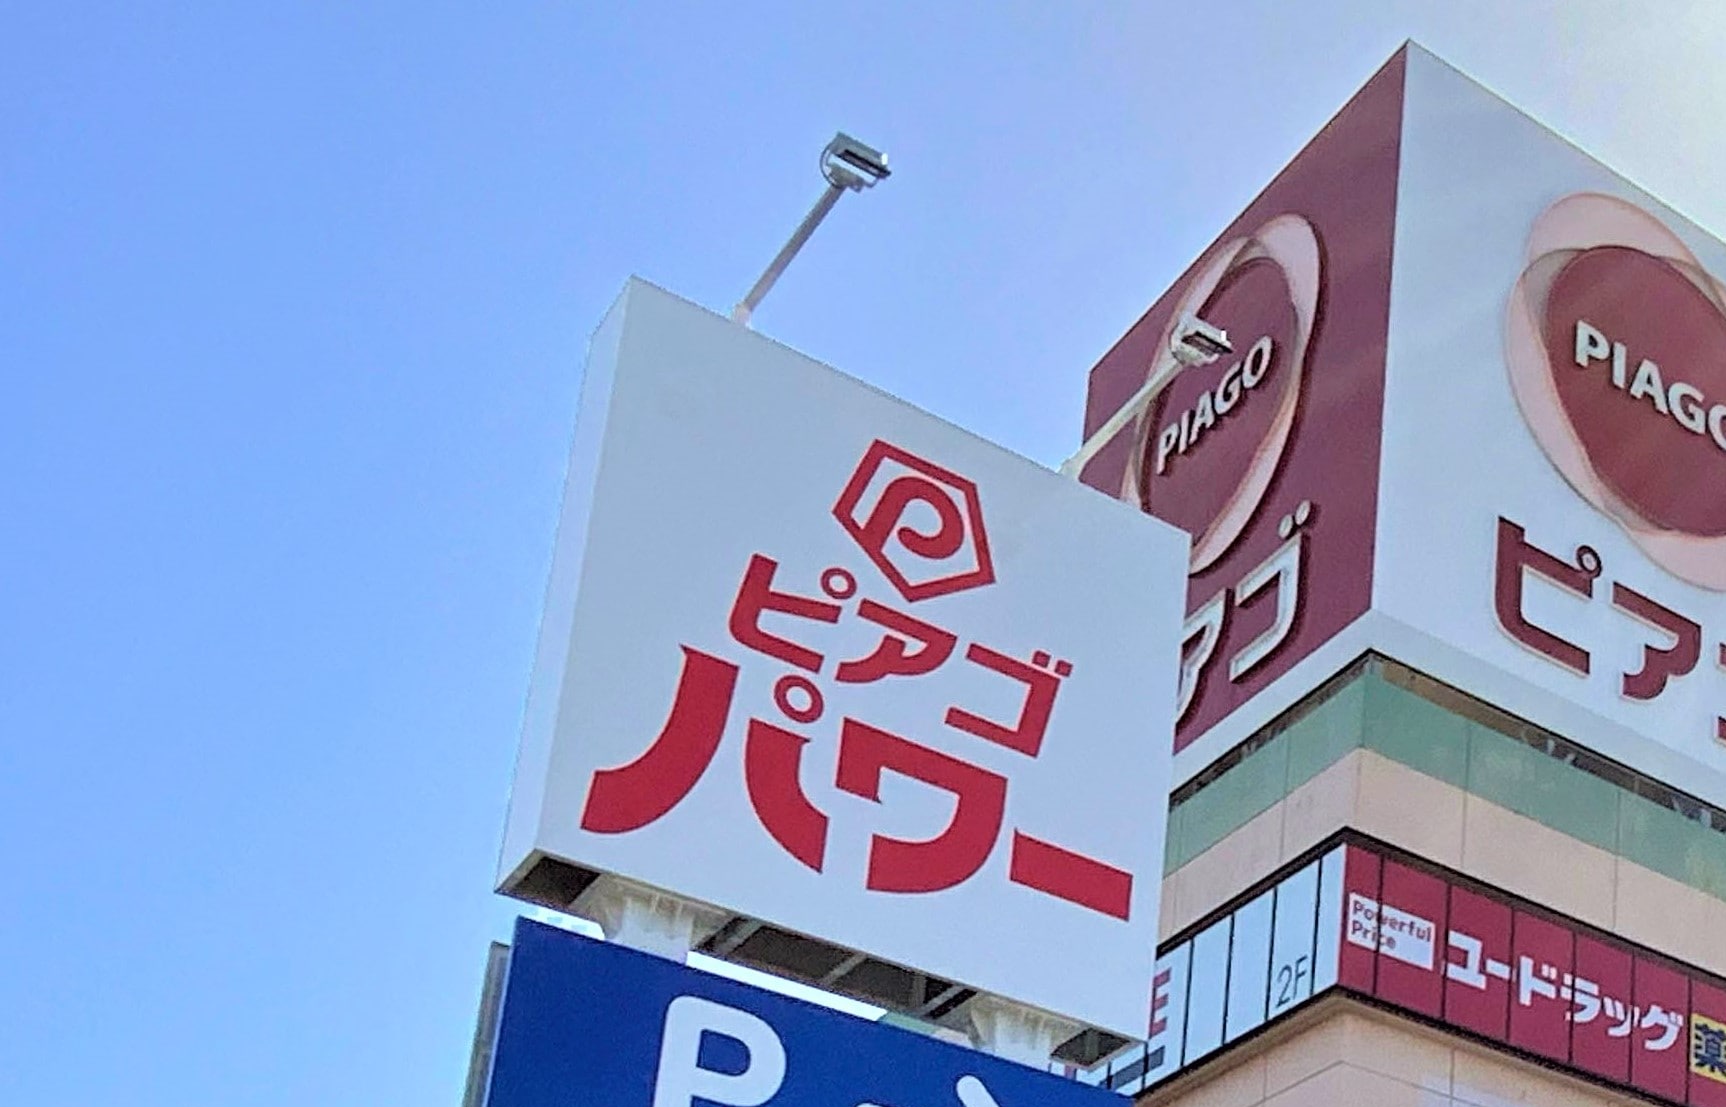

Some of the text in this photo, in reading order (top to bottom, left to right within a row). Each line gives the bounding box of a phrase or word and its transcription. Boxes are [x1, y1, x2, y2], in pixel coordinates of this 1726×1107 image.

[1155, 335, 1274, 475] PIAGO
[728, 553, 1074, 758] ピアゴ
[580, 643, 1134, 923] パワー
[1275, 954, 1308, 1009] 2F
[1443, 930, 1685, 1051] ユードラッグ
